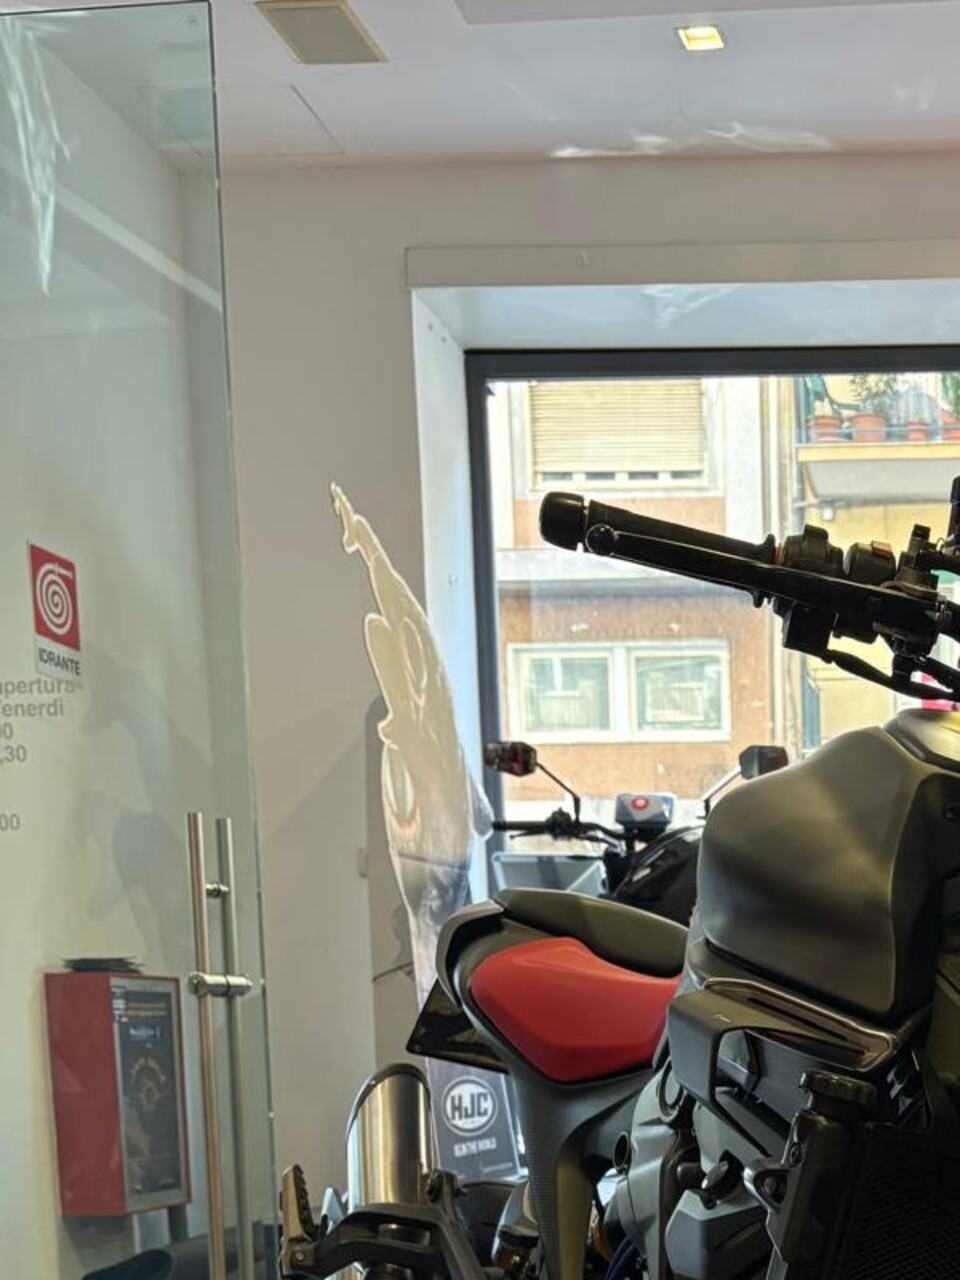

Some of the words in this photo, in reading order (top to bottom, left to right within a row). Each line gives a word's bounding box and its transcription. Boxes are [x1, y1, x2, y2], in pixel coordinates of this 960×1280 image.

[38, 648, 81, 676] IDRANTE
[0, 678, 76, 699] pertura
[451, 1093, 488, 1120] HJC
